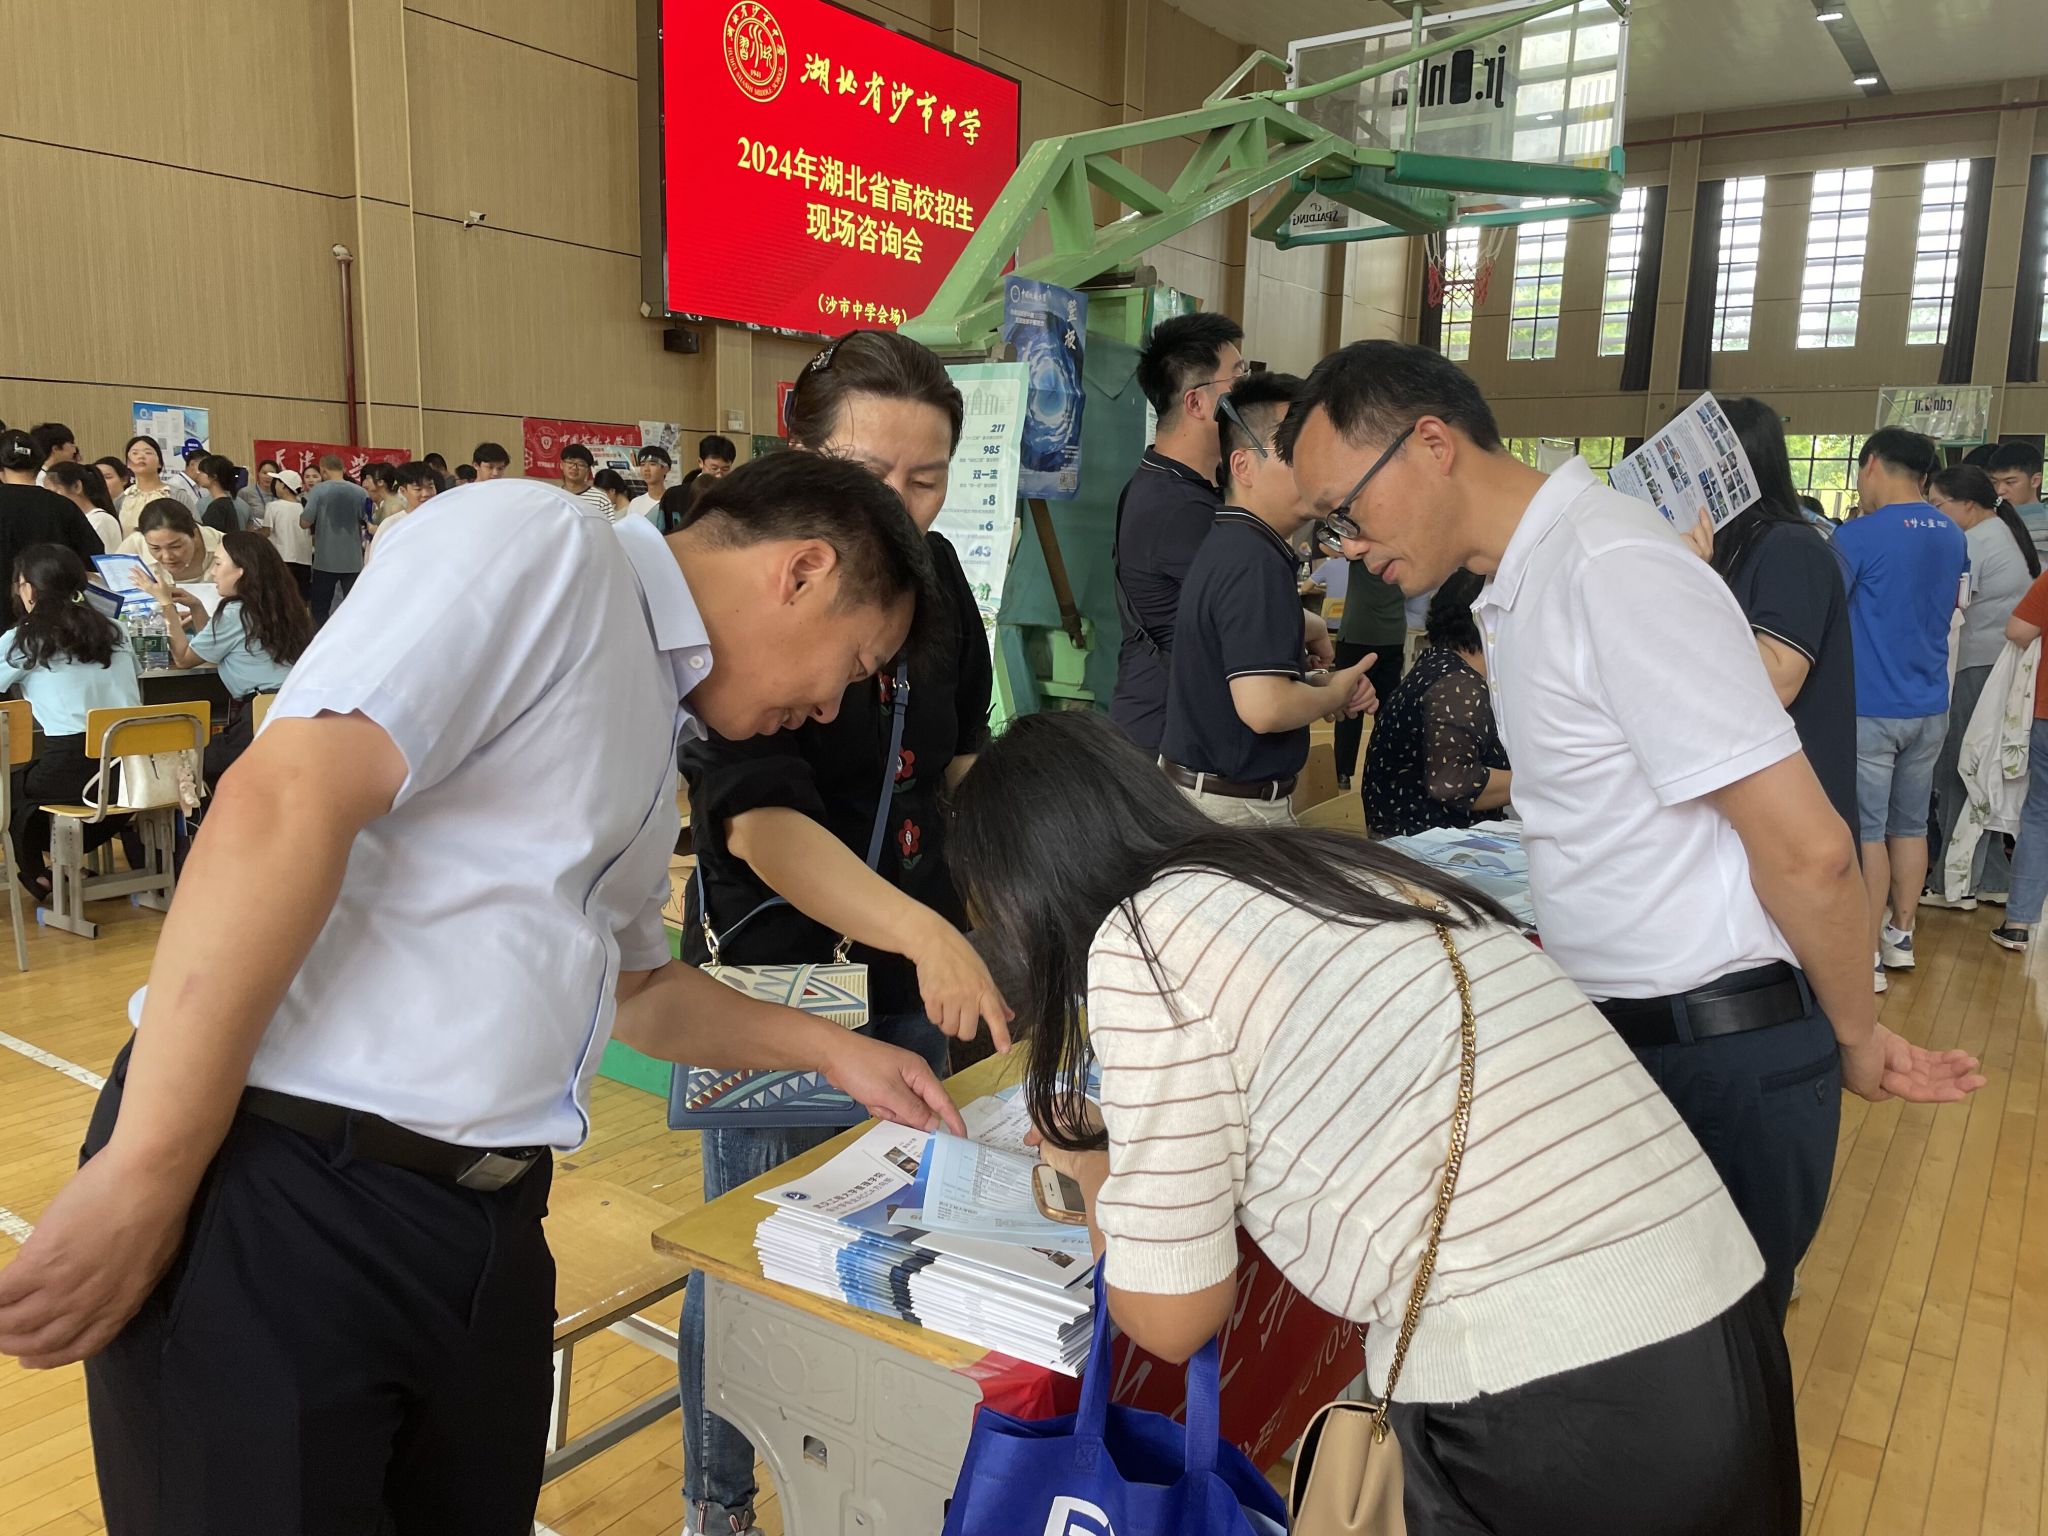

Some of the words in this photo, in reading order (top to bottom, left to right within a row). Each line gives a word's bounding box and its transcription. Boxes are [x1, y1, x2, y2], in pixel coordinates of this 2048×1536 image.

[800, 53, 981, 146] 湖北省沙市中学
[737, 136, 975, 233] 2024年湖北省高校招生
[806, 202, 924, 264] 现场咨询会
[983, 445, 1001, 455] 985
[990, 424, 1006, 433] 211
